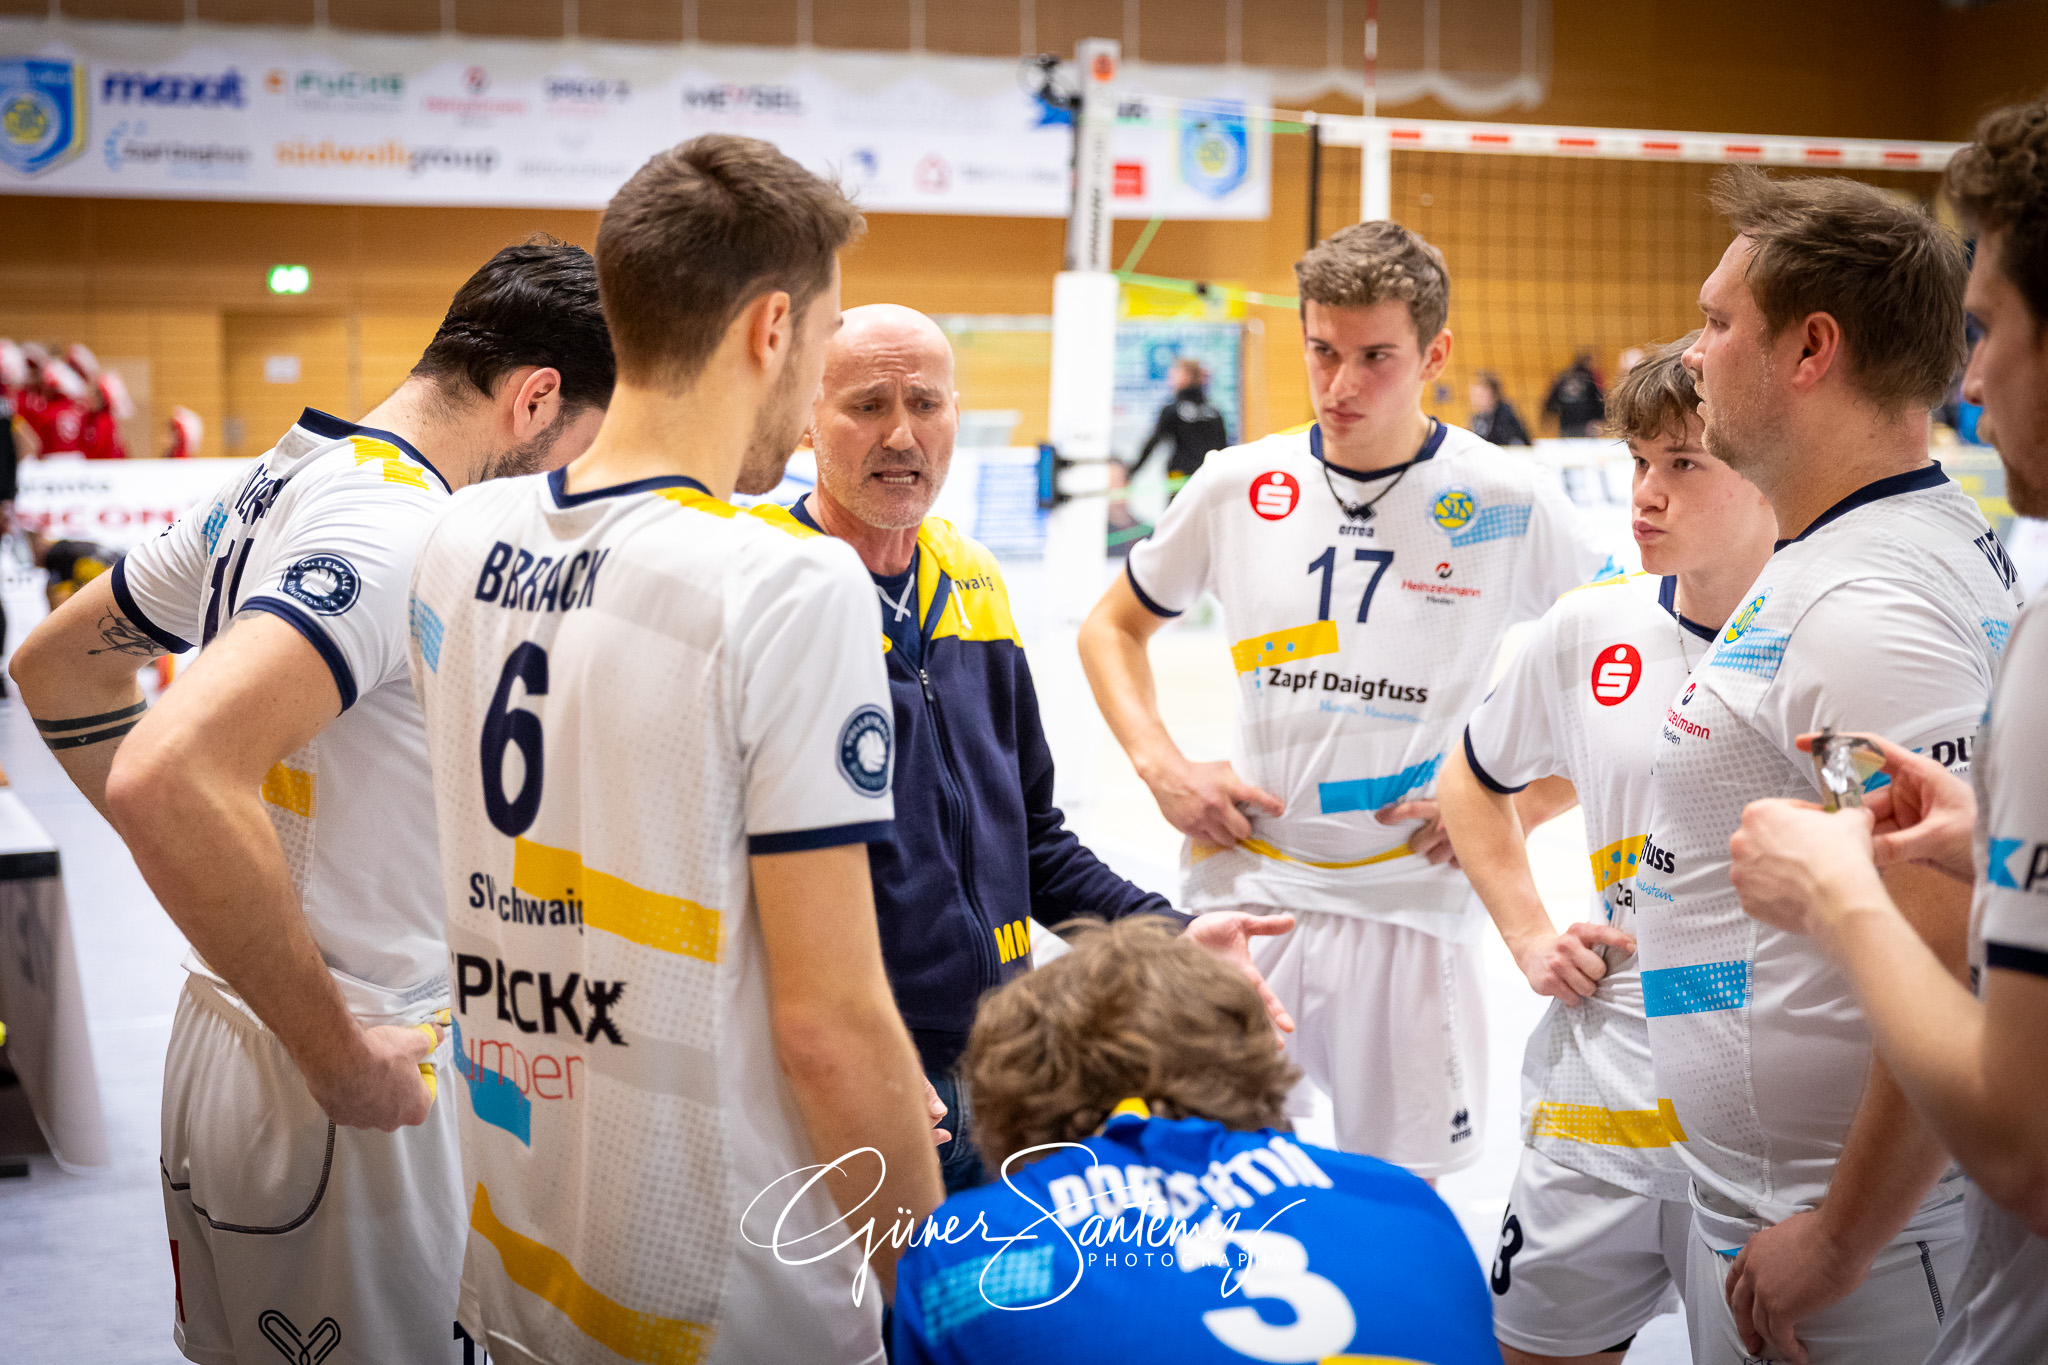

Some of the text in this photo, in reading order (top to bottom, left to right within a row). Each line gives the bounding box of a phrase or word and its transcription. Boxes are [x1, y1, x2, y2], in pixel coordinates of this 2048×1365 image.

[1308, 547, 1394, 623] 17
[1401, 580, 1481, 597] Heinzelmann
[1269, 667, 1428, 703] Zapf Daigfuss
[480, 641, 549, 837] 6
[1667, 708, 1710, 740] nzelmann
[1616, 882, 1636, 914] Za
[452, 952, 583, 1035] PCK
[1175, 1210, 1357, 1364] 3
